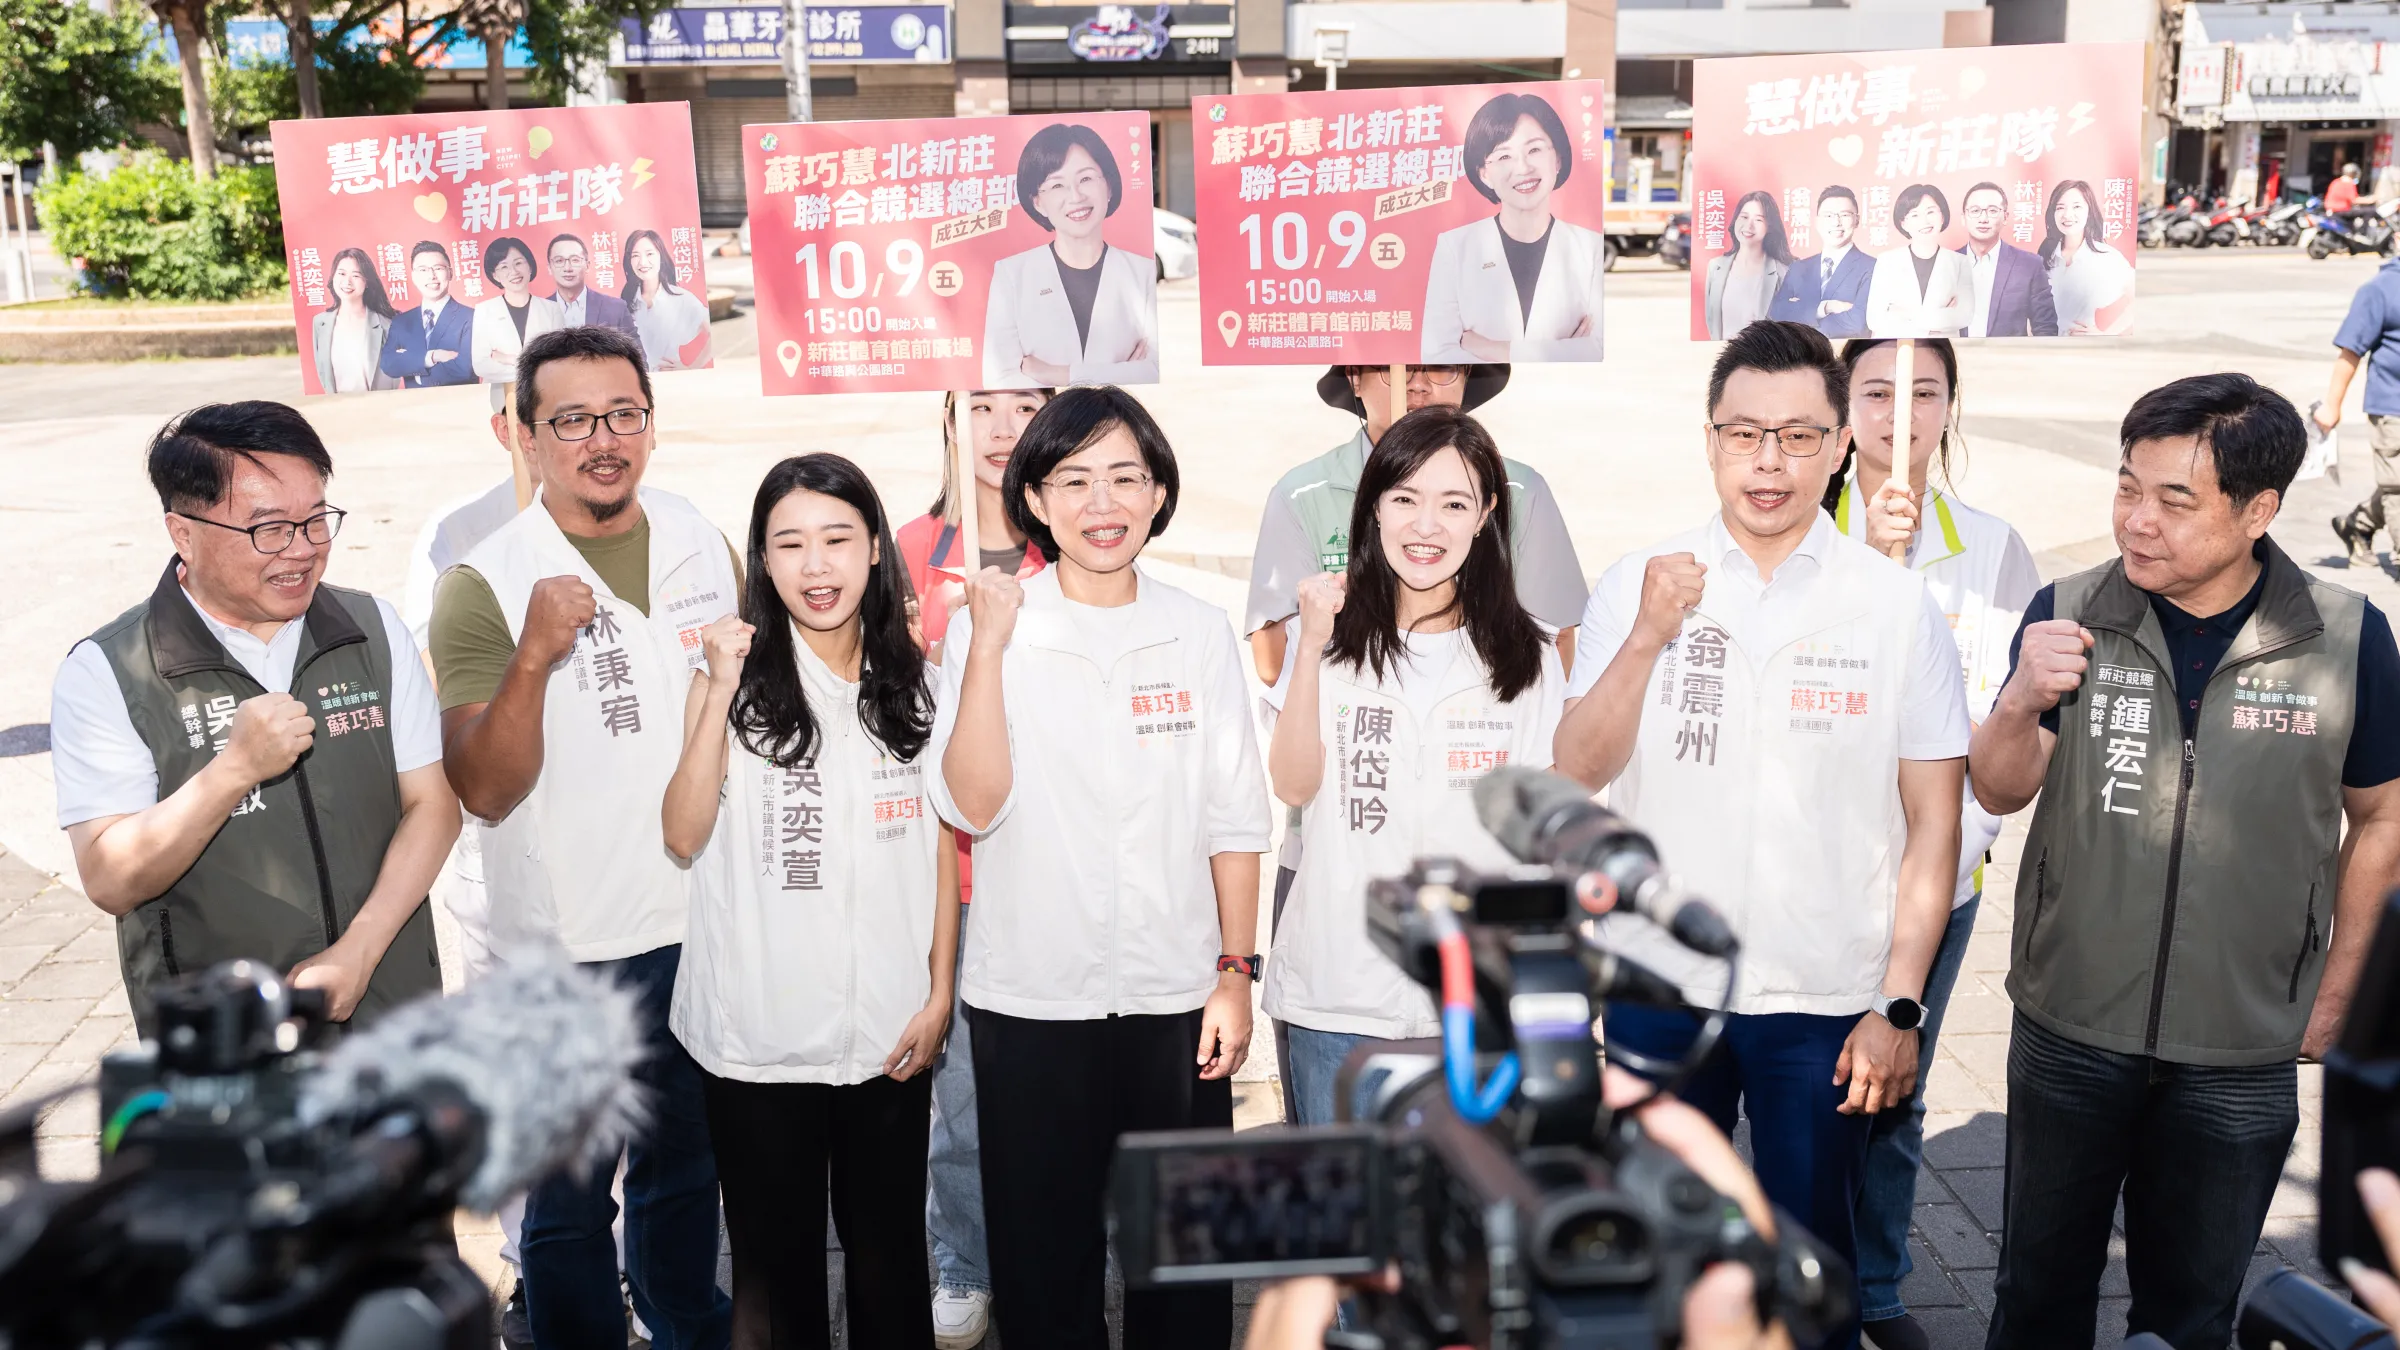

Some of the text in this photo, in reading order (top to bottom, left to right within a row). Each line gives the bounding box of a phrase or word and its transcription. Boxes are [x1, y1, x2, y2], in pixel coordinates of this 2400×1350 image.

[703, 10, 863, 41] 晶華牙診所
[1186, 38, 1219, 55] 24H
[1743, 64, 1917, 136] 慧做事
[327, 125, 491, 195] 慧做事
[496, 153, 521, 162] TAIPEI
[496, 162, 515, 170] CITY
[1875, 106, 2058, 179] 新莊隊
[461, 161, 624, 234] 新莊隊
[1239, 143, 1466, 203] 聯合競選總部
[1378, 180, 1449, 216] 成立大會
[793, 173, 1020, 232] 聯合競選總部
[935, 208, 1004, 244] 成立大會
[1705, 189, 1725, 249] 吳奕萱
[2013, 180, 2035, 242] 林秉宥
[2102, 178, 2126, 240] 陳岱吟
[459, 239, 483, 297] 蘇巧慧
[591, 231, 615, 289] 林秉宥
[671, 226, 693, 283] 陳岱吟
[795, 239, 956, 300] 10/9 五
[1239, 210, 1399, 271] 10/9 五
[301, 247, 327, 306] 吳奕萱
[384, 242, 409, 302] 翁震州
[1245, 278, 1376, 305] 15:00 開始入場
[804, 306, 937, 334] 15:00 開始入場
[1247, 310, 1413, 333] 新莊體育館前廣場
[1247, 335, 1343, 350] 中華路與公園路口
[807, 337, 974, 363] 新莊體育館前廣場
[808, 363, 905, 379] 中華路與公園路口
[585, 604, 642, 737] 林秉宥
[1660, 641, 1679, 706] 新北市議員
[1793, 655, 1814, 667] 溫暖
[1817, 657, 1837, 669] 創新
[2097, 666, 2154, 687] 新莊競總
[1131, 690, 1193, 718] 蘇巧慧
[1675, 626, 1730, 766] 翁震州
[1790, 688, 1868, 715] 蘇巧慧
[2089, 693, 2108, 737] 總幹事
[2232, 705, 2318, 736] 蘇巧慧
[2234, 688, 2318, 707] 溫暖 創新 會做事
[181, 703, 205, 749] 總幹事
[2101, 694, 2152, 816] 鍾宏仁
[1349, 706, 1393, 835] 陳岱吟
[762, 773, 775, 877] 新北市議員候選人
[781, 757, 823, 891] 吳奕萱
